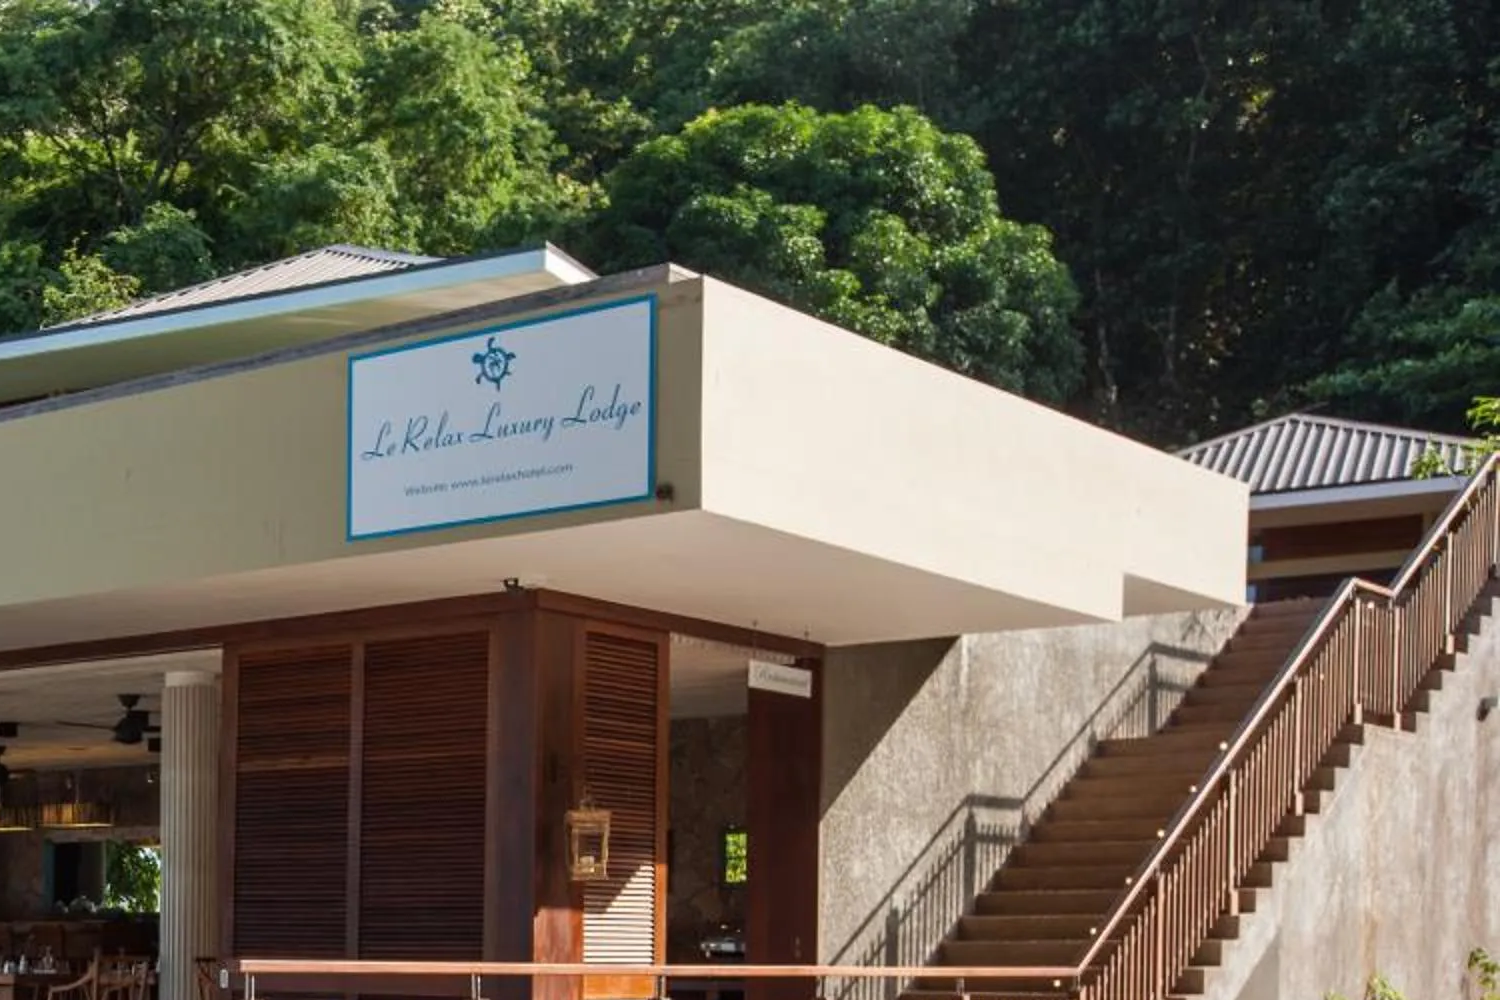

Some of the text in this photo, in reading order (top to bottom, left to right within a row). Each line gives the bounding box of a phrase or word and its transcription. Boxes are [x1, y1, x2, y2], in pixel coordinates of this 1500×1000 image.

[361, 383, 642, 460] Le Relax Luxury Lodge
